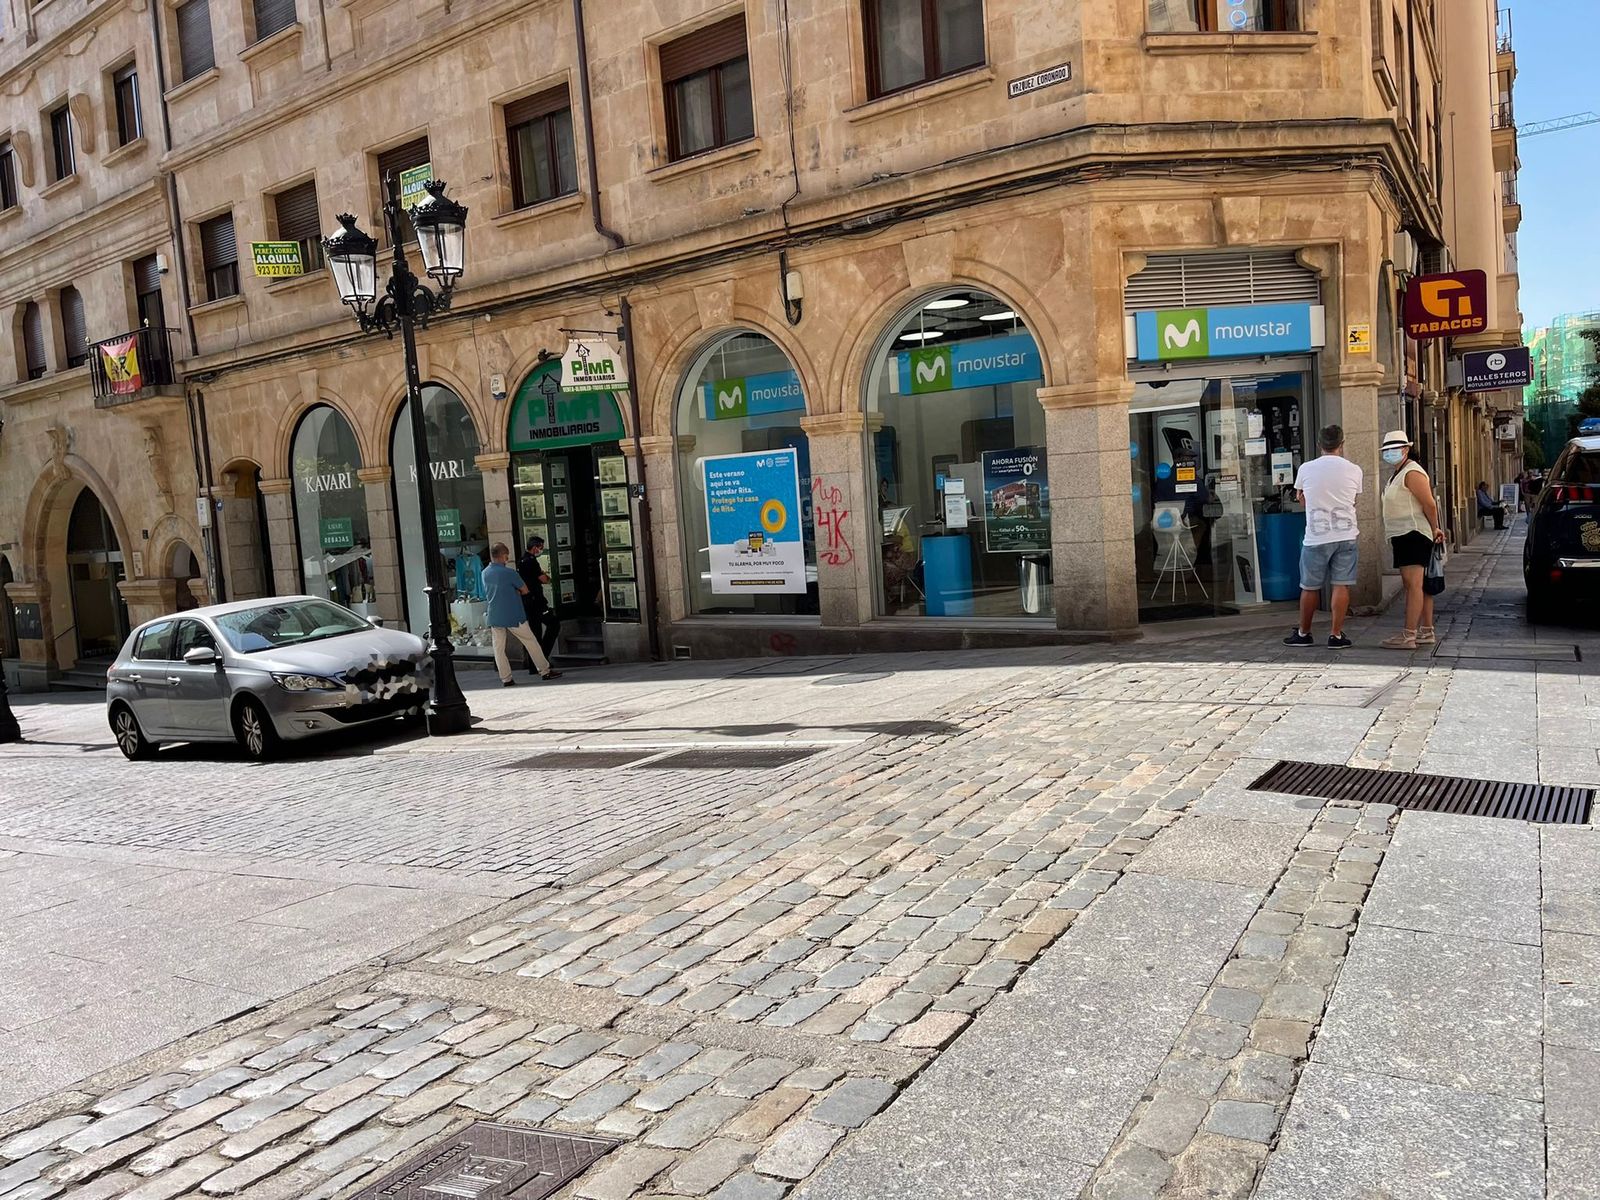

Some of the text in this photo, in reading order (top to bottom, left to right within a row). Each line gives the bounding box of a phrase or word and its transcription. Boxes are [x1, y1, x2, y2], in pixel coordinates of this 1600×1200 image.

[1012, 68, 1066, 93] VAZQUEZ CORONADO
[256, 254, 299, 264] ALQUILA
[257, 265, 301, 275] 923 27 02 23
[1215, 321, 1292, 339] movistar
[1410, 317, 1482, 334] TABACOS
[958, 352, 1026, 373] movistar
[1467, 370, 1527, 382] BALLESTEROS
[529, 422, 600, 440] INMOBILIARIOS
[1014, 455, 1038, 464] FUSIÓN
[409, 458, 466, 482] KVARI
[305, 472, 352, 494] KAVARI
[710, 479, 724, 488] aquí
[716, 487, 737, 497] quedar
[738, 486, 753, 494] Rita.
[711, 497, 736, 505] Protege
[324, 536, 349, 544] REBAJAS
